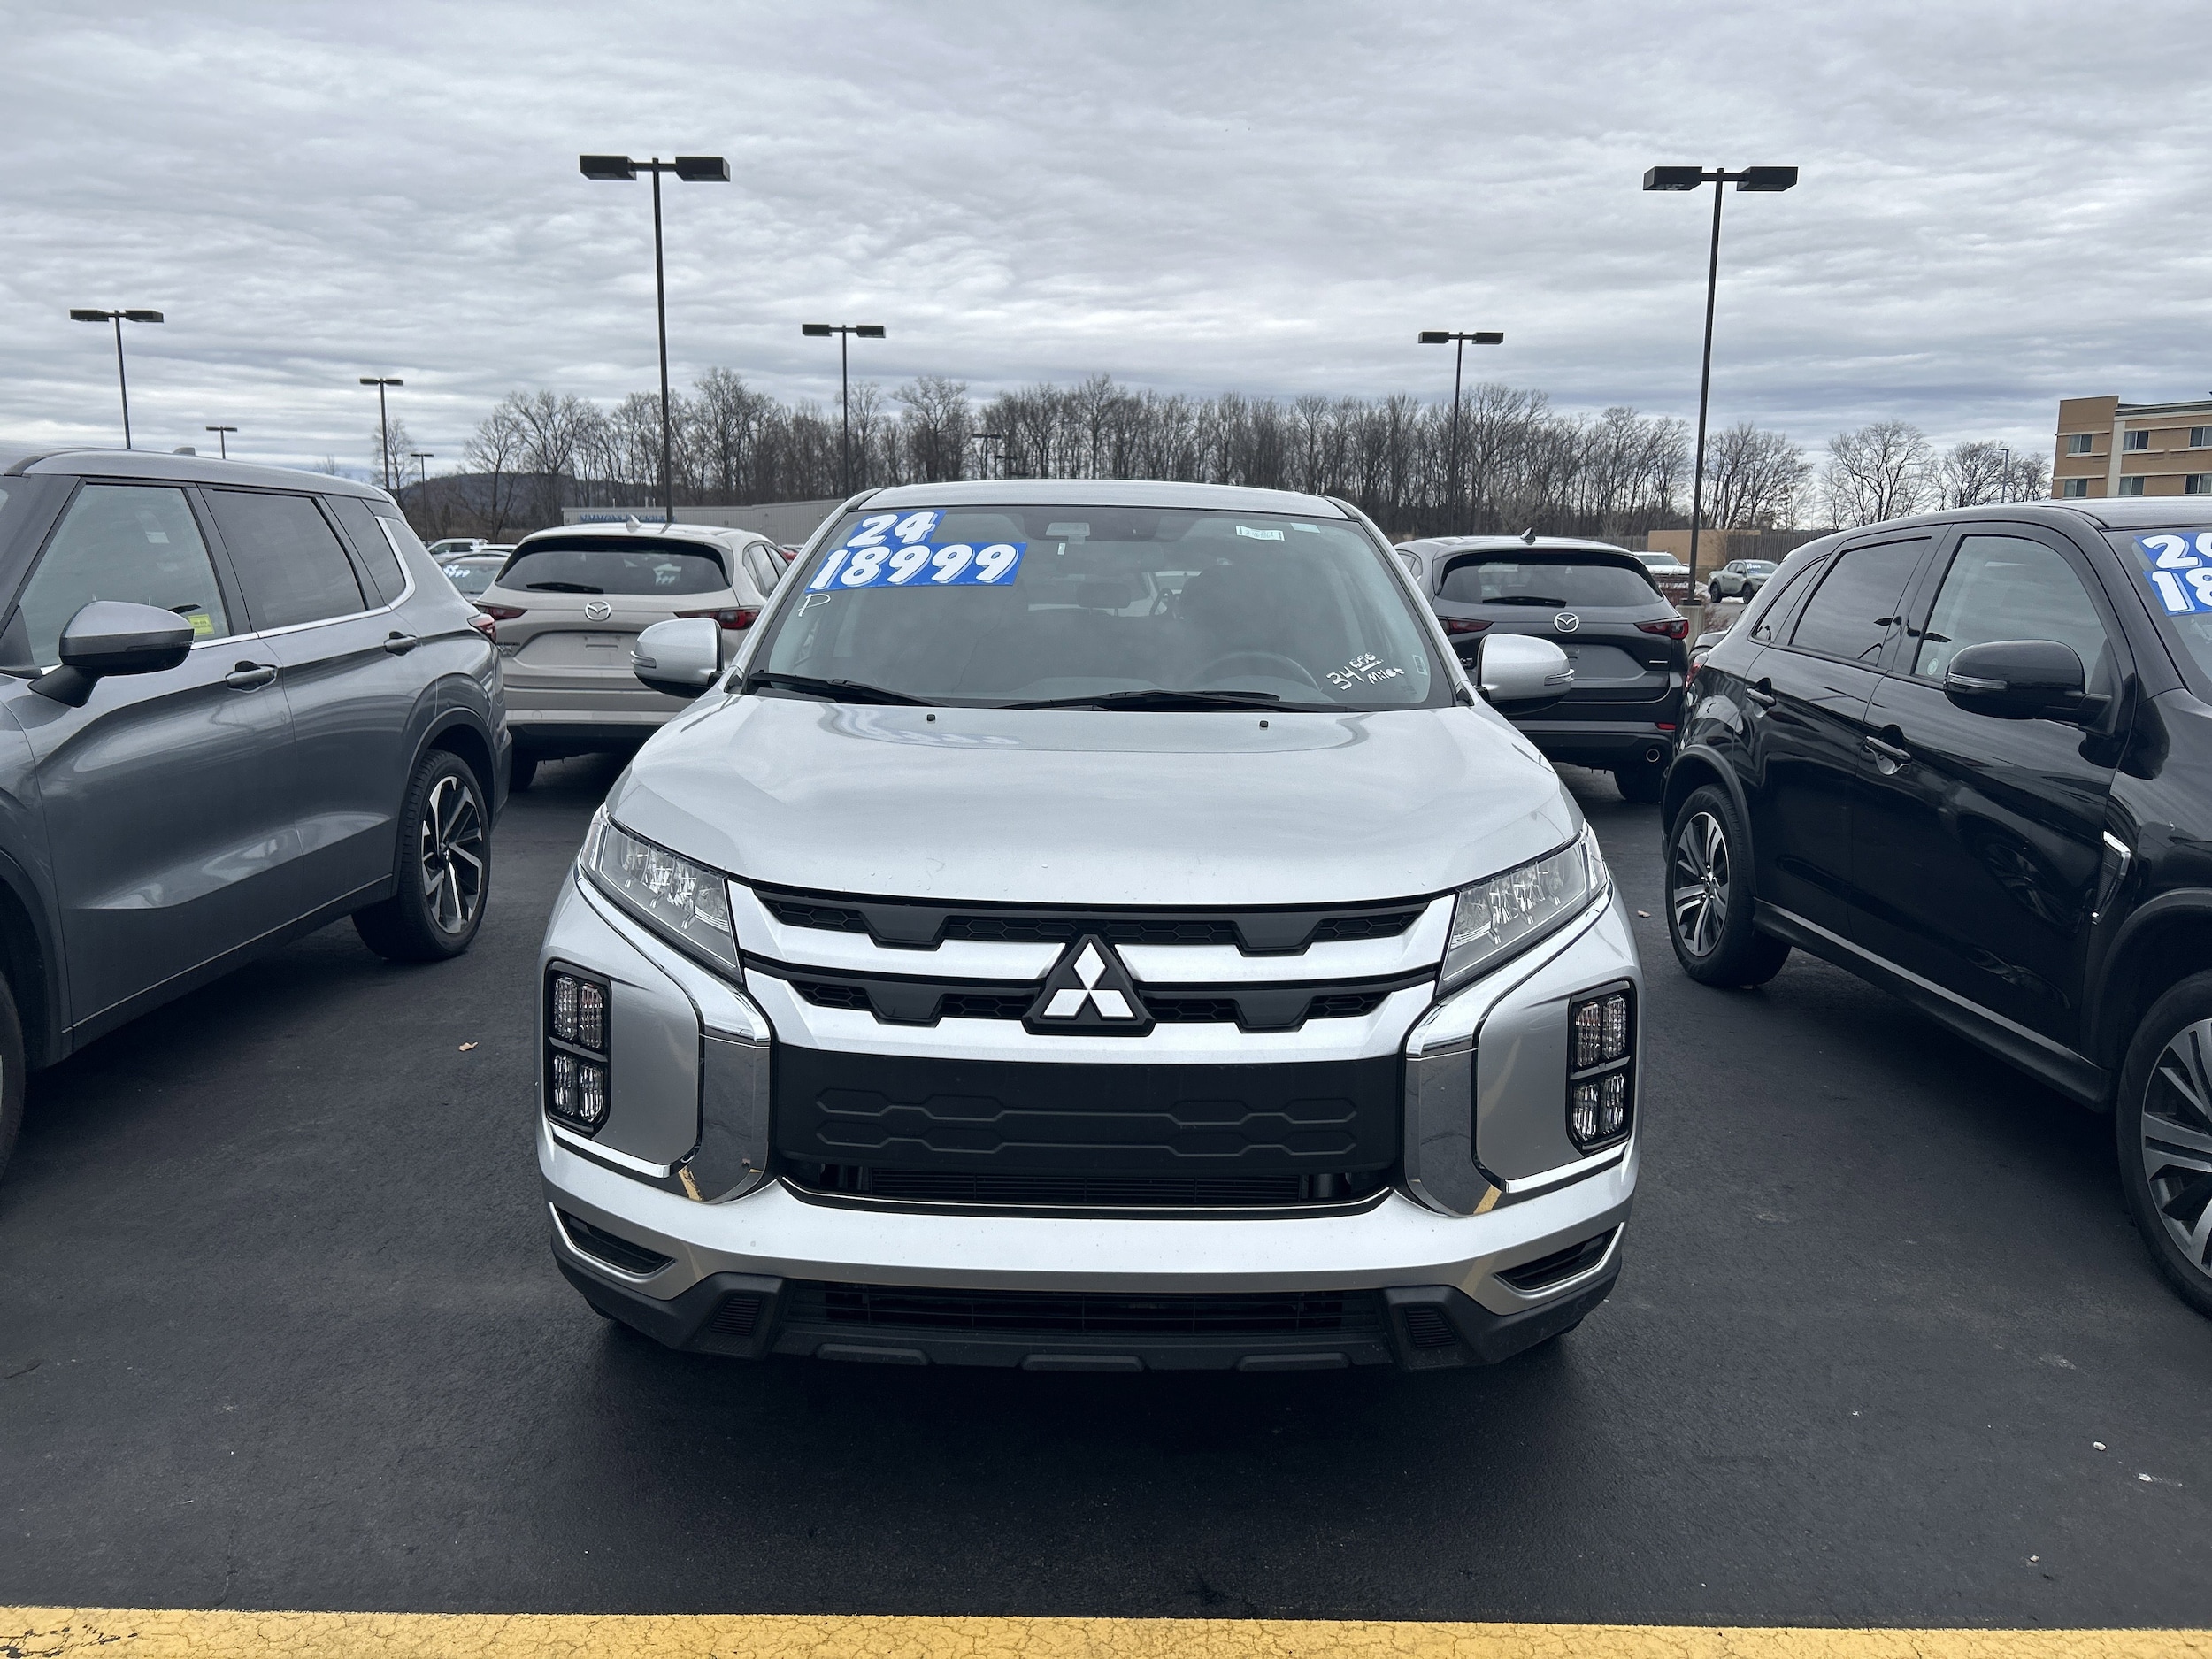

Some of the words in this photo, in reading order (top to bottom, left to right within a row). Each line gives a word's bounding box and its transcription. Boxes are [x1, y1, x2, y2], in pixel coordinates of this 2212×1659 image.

[847, 511, 939, 547] 24
[810, 544, 1019, 589] 18999
[797, 594, 831, 617] P
